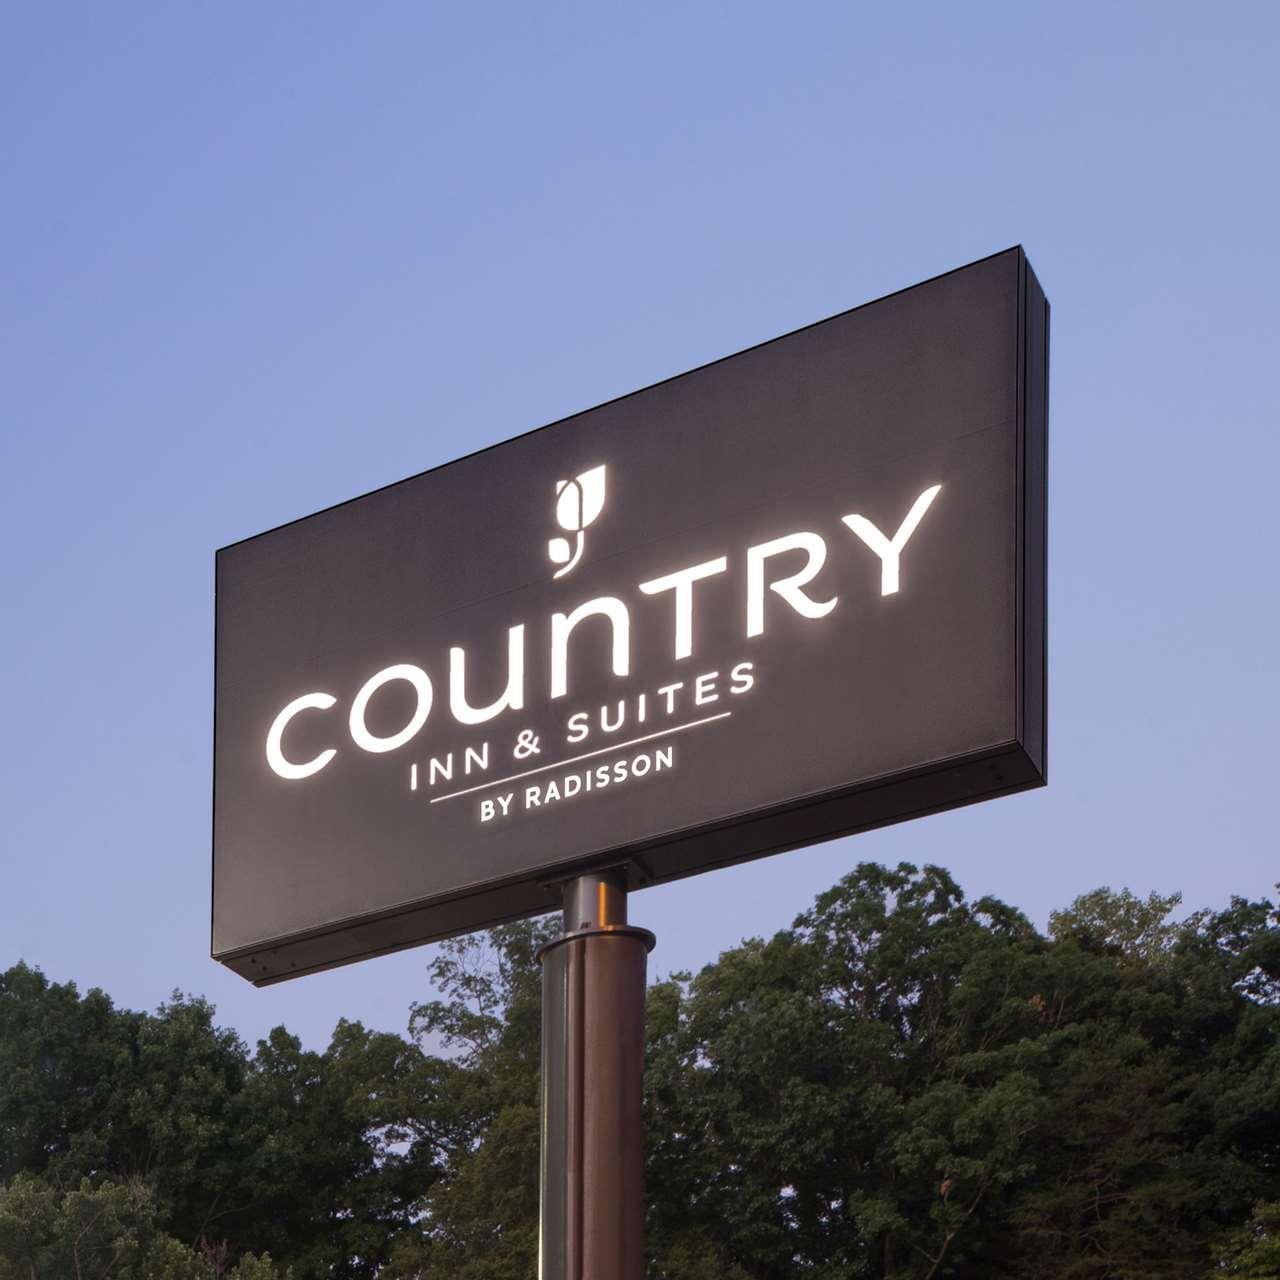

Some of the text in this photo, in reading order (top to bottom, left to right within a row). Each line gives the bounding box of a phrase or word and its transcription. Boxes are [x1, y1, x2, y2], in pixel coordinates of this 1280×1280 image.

[410, 662, 755, 791] INN & SUITES
[480, 747, 673, 822] BY RADISSON
